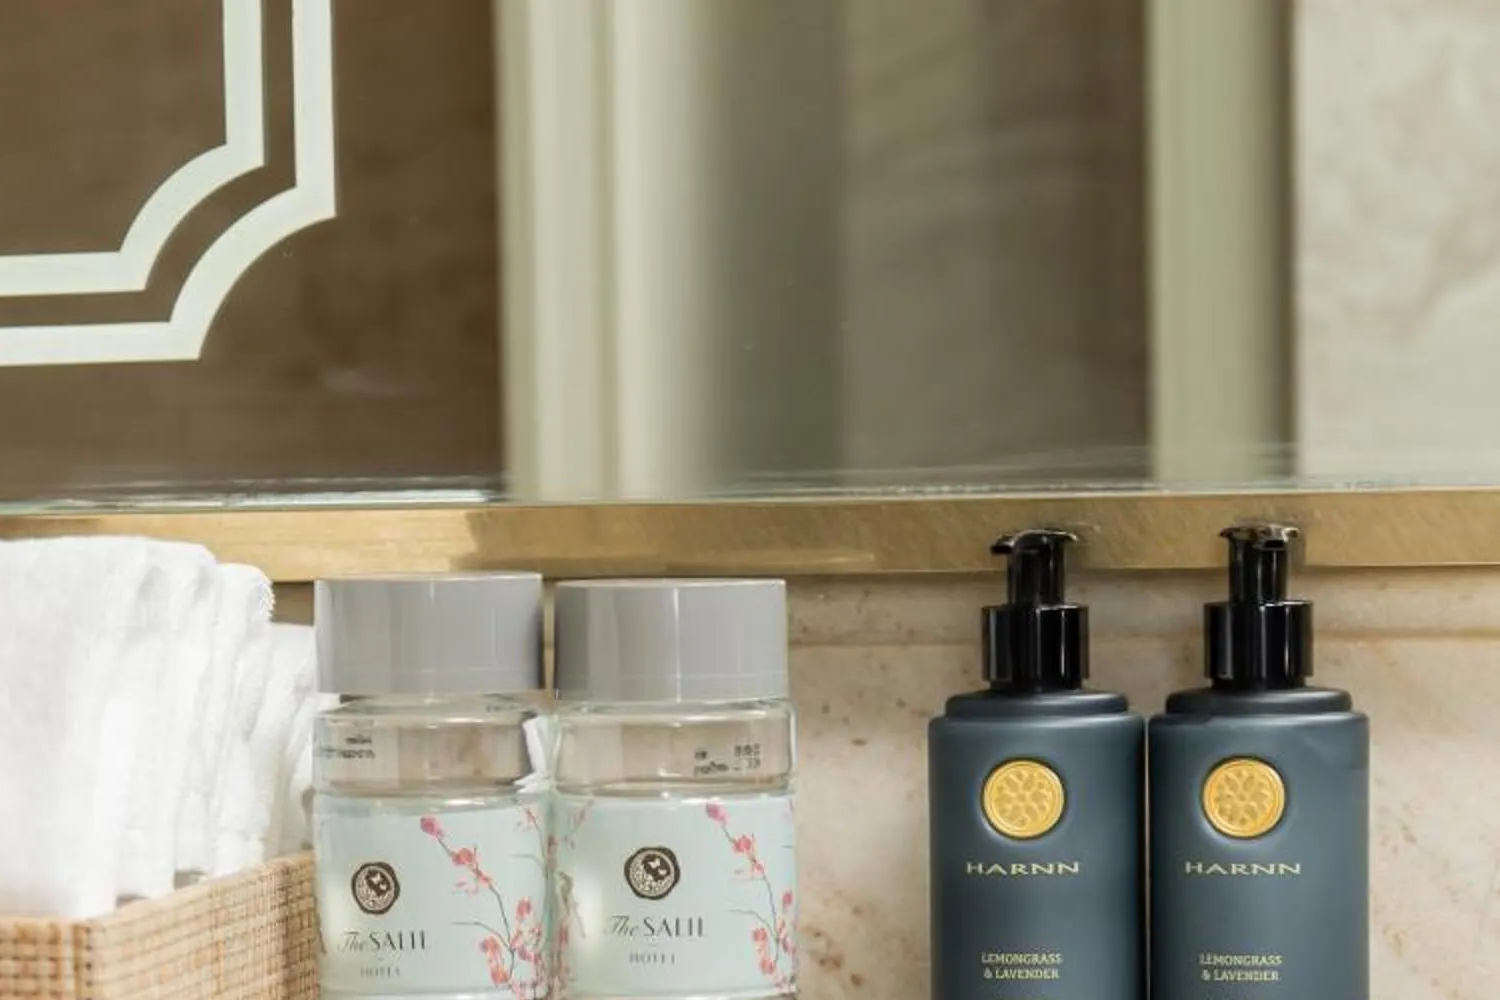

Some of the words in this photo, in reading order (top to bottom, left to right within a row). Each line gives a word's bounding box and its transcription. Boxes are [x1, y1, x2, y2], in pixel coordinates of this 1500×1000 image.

[966, 861, 1080, 876] HARNN
[1185, 861, 1301, 876] HARNN
[981, 952, 1062, 965] LEMONGRASS
[1200, 953, 1282, 966] LEMONGRASS
[995, 967, 1060, 980] LAVENDER
[1213, 969, 1279, 982] LAVENDER
